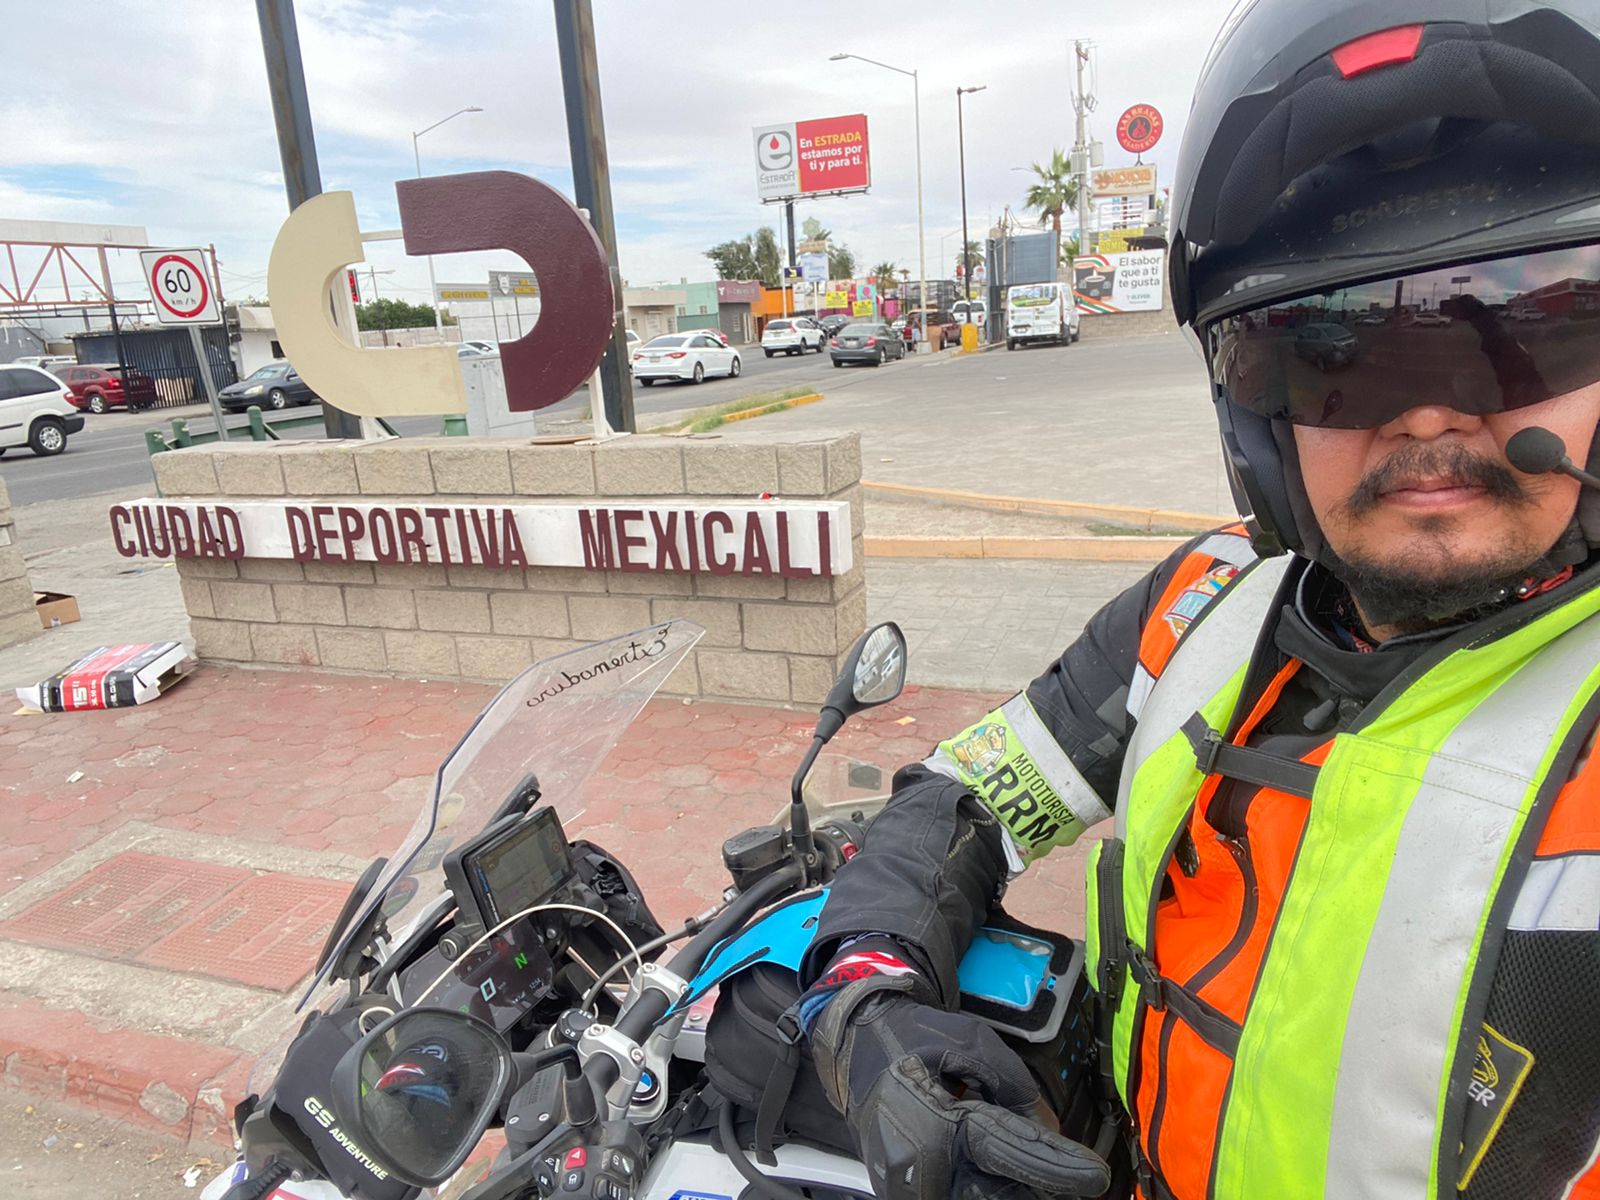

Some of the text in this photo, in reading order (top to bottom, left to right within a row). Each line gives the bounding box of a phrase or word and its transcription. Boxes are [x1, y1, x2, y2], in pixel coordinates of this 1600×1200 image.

[800, 131, 862, 148] En ESTRADA
[801, 145, 863, 160] estamos por
[809, 161, 817, 170] ti
[819, 162, 825, 172] y
[828, 159, 850, 171] para
[1120, 255, 1161, 266] El sabor
[165, 268, 191, 293] 60
[1121, 269, 1141, 278] que
[1151, 266, 1158, 275] ti
[1119, 278, 1160, 289] te gusta
[109, 505, 833, 579] CIUDAD DEPORTIVA MEXICALI
[1012, 753, 1075, 826] MOTOTURISTA
[982, 763, 1060, 848] RRM
[515, 953, 528, 970] N
[303, 1096, 389, 1181] GS ADVENTURE
